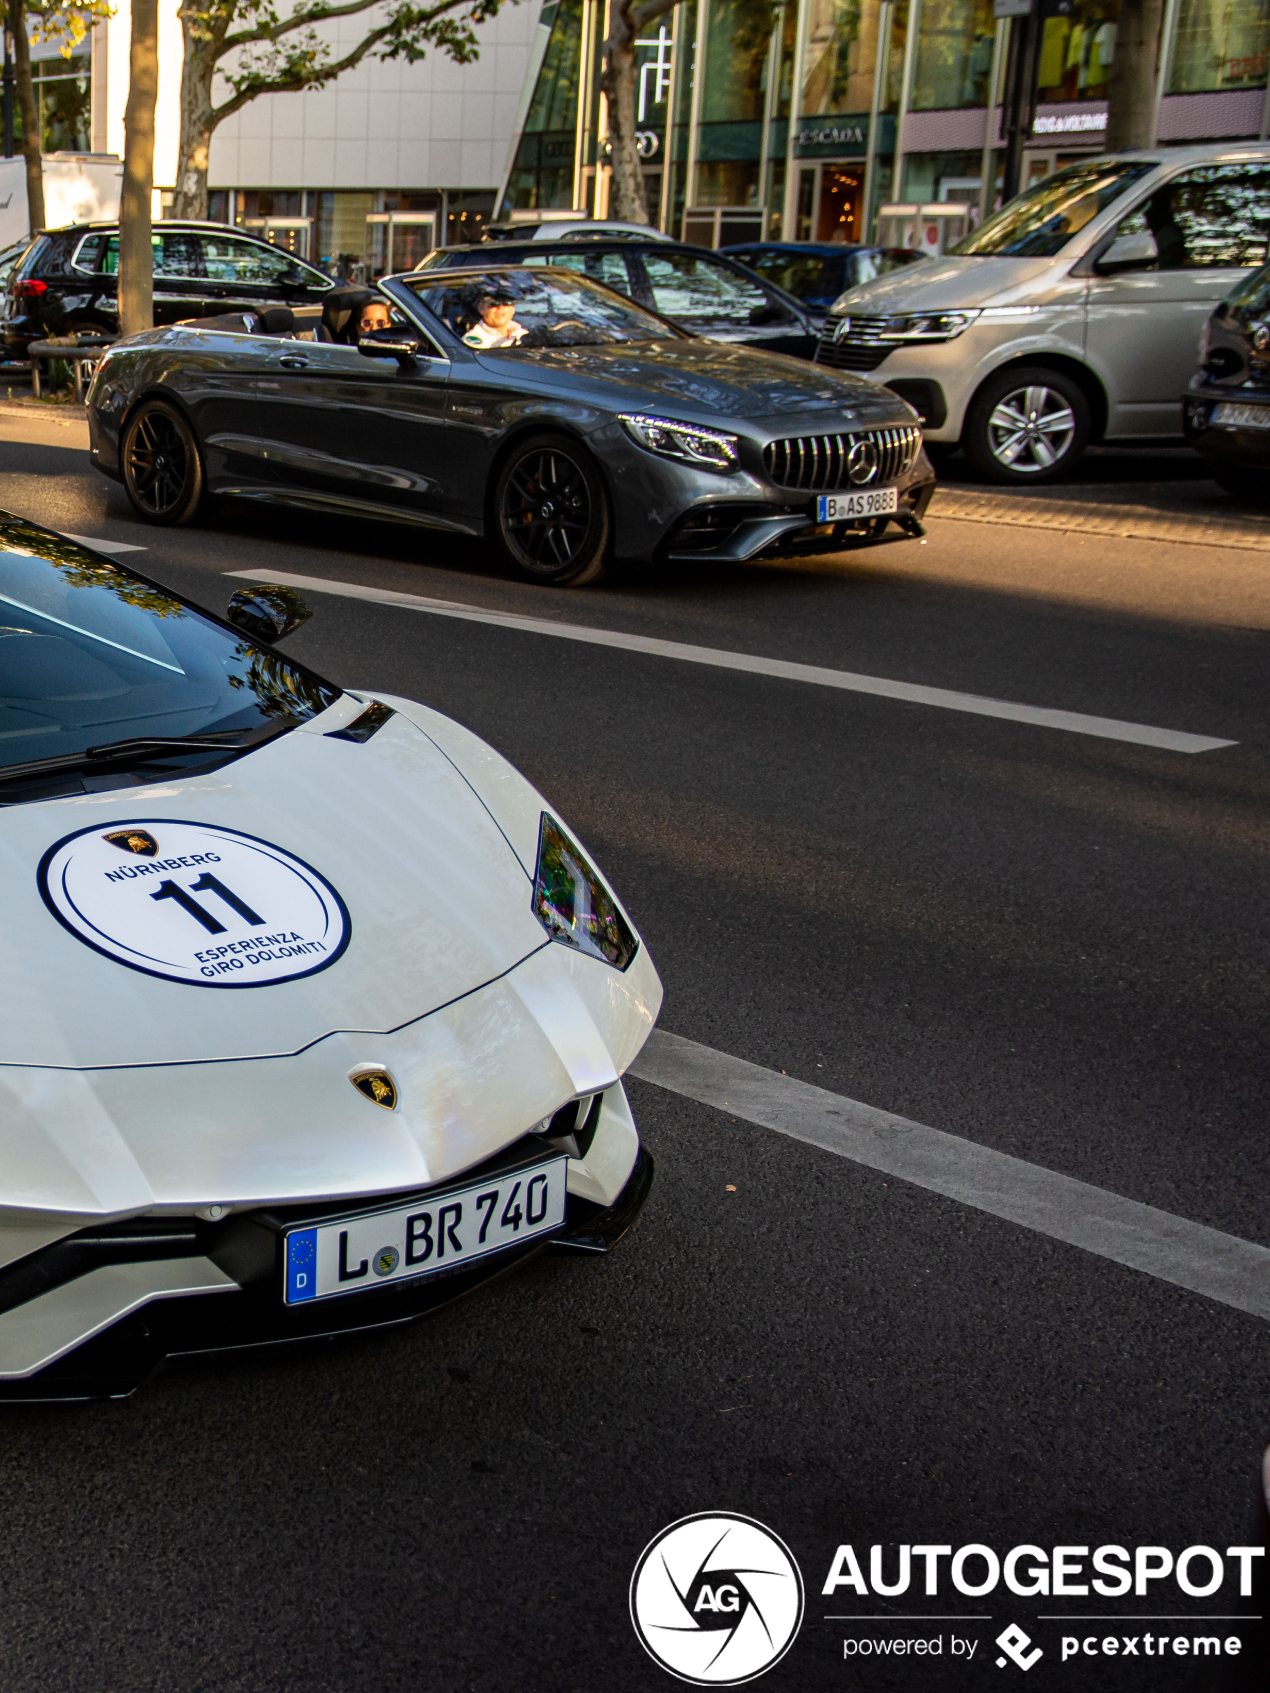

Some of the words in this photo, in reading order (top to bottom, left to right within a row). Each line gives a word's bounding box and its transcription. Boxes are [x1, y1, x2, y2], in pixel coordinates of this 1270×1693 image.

[800, 127, 863, 145] ESCADA
[828, 499, 837, 517] B
[847, 496, 865, 515] AS
[867, 491, 895, 513] 9888
[104, 852, 222, 883] NÜRNBERG
[148, 872, 267, 935] 11
[194, 932, 305, 963] ESPERIENZA
[200, 958, 244, 977] GIRO
[245, 941, 327, 965] DOLOMITI
[338, 1230, 369, 1282] L
[405, 1202, 462, 1266] BR
[476, 1173, 548, 1244] 740
[296, 1273, 307, 1289] D
[395, 1274, 436, 1291] SPEED
[439, 1257, 485, 1280] ATELIER
